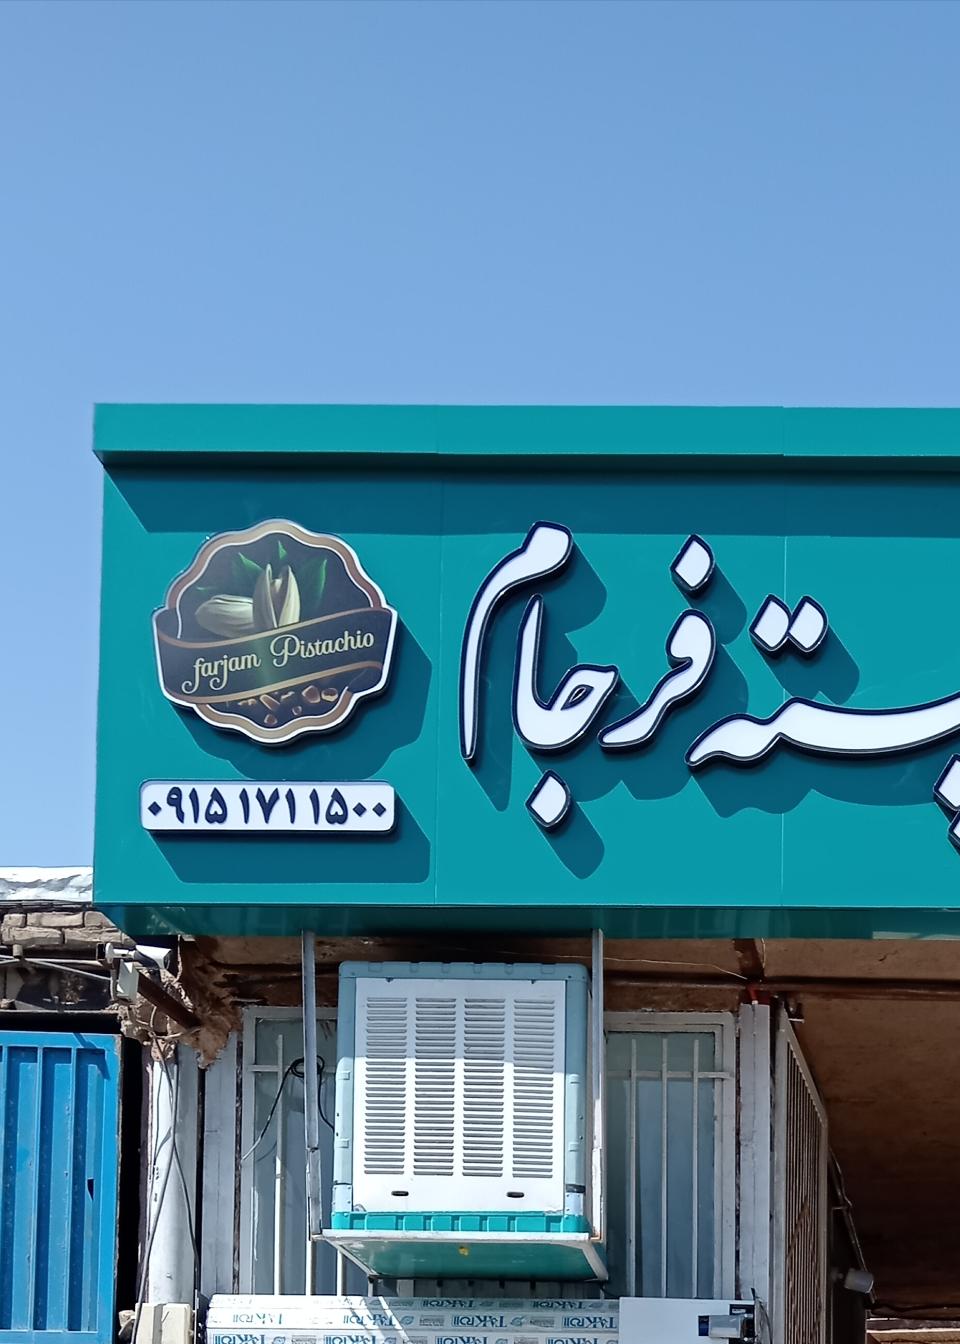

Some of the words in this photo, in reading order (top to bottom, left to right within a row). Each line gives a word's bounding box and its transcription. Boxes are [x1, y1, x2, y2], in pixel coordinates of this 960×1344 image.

[180, 653, 262, 695] farjam
[269, 630, 375, 668] Pistachio
[459, 521, 716, 830] فرجام
